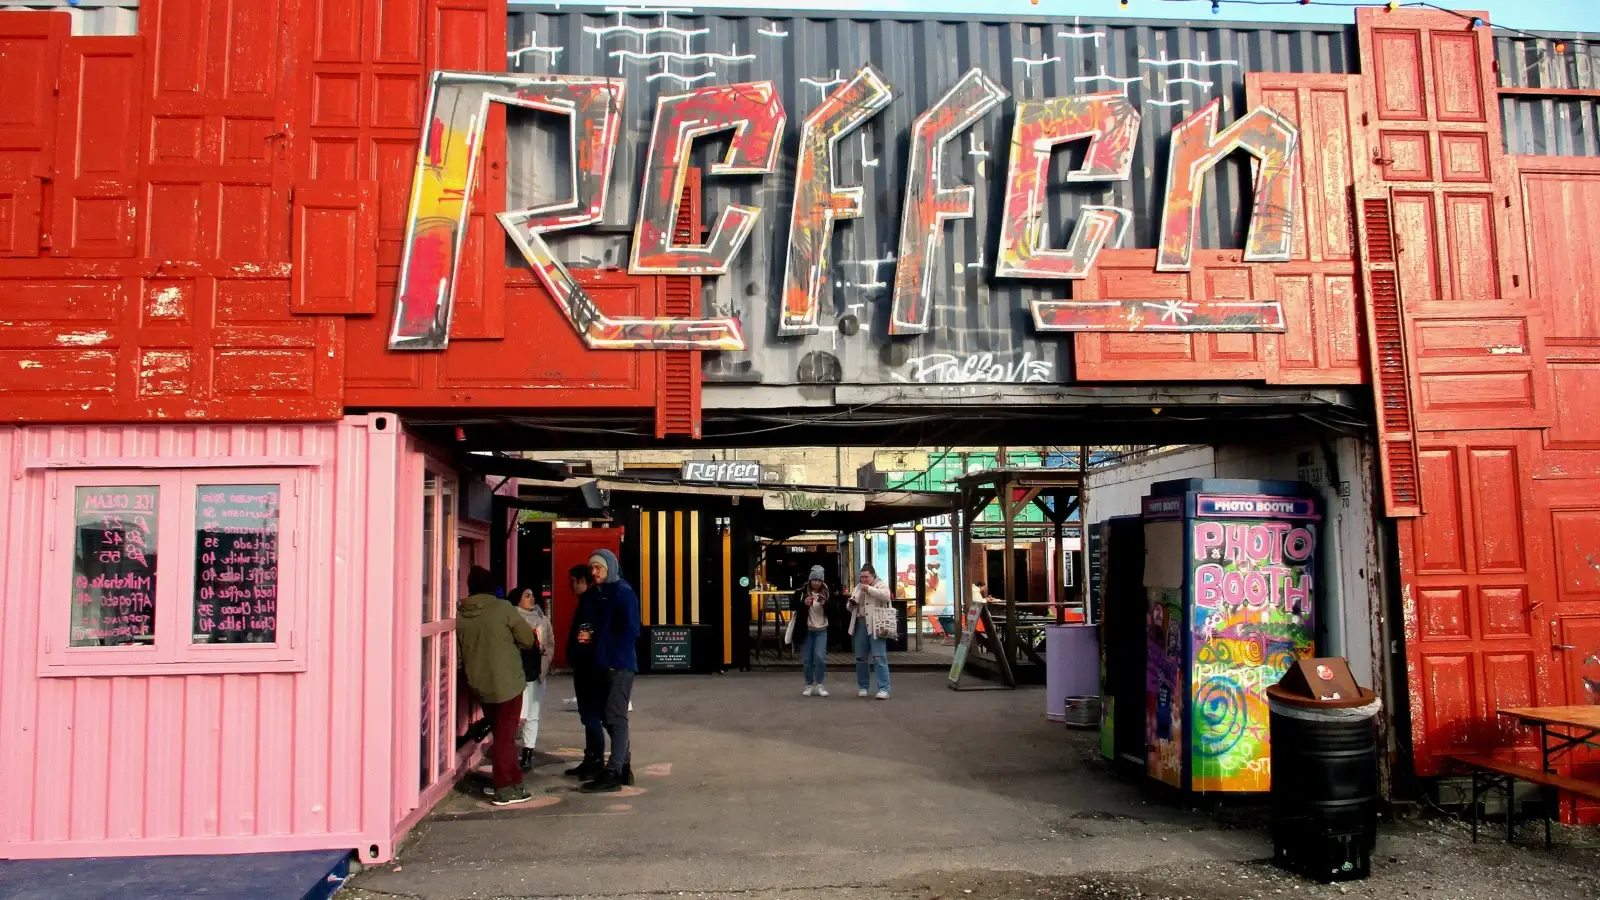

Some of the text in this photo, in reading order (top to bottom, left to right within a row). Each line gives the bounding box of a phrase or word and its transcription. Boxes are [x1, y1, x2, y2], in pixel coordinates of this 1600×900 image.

[835, 501, 850, 512] bar
[1214, 501, 1294, 513] PHOTO BOOTH
[1194, 521, 1314, 564] PHOTO
[1194, 563, 1312, 613] BOOTH
